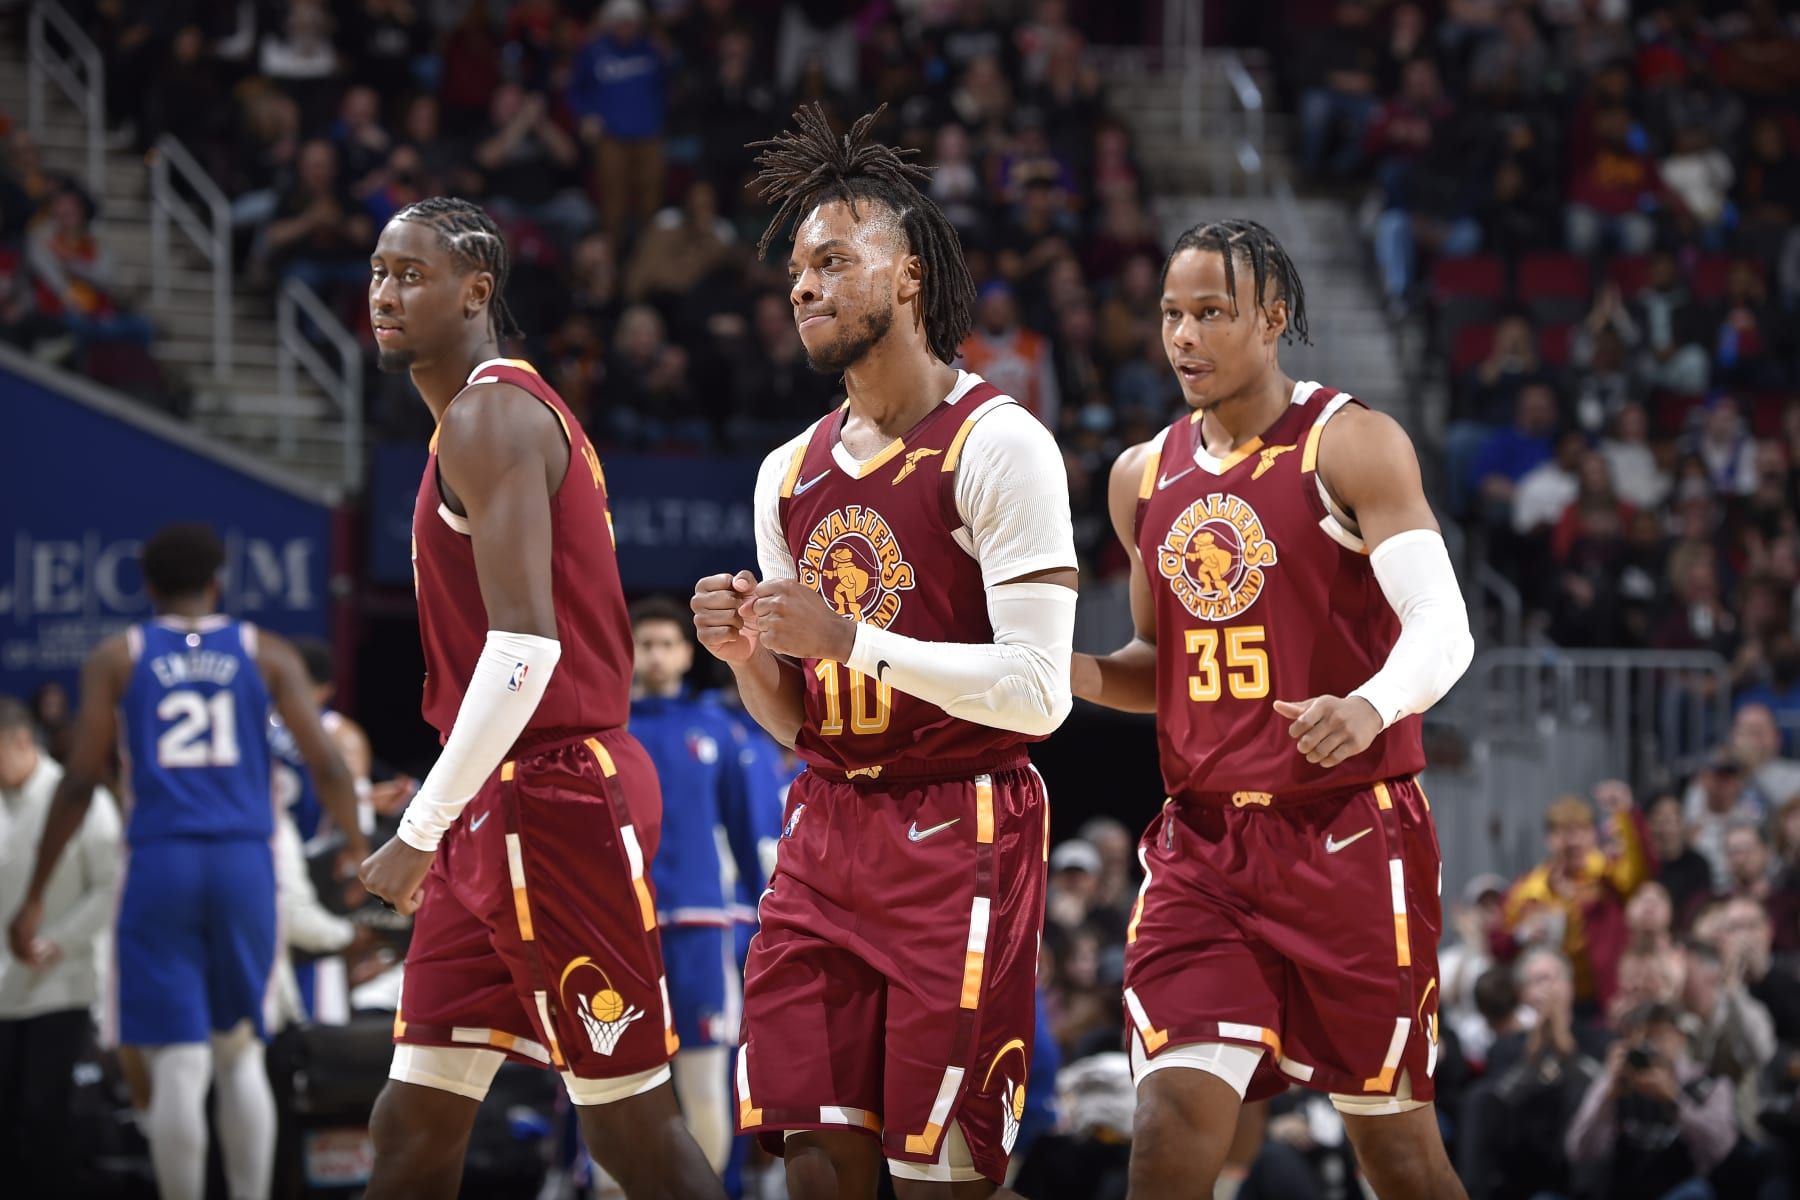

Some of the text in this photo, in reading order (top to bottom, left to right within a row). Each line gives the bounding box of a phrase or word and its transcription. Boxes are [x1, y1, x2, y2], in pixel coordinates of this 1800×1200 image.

[799, 505, 915, 591] CAVALIERS
[1157, 493, 1277, 578] CAVALIERS
[0, 538, 315, 614] ECM
[1171, 568, 1264, 621] CLEVELAND
[815, 658, 892, 736] 10
[1184, 626, 1269, 701] 35
[157, 690, 240, 768] 21
